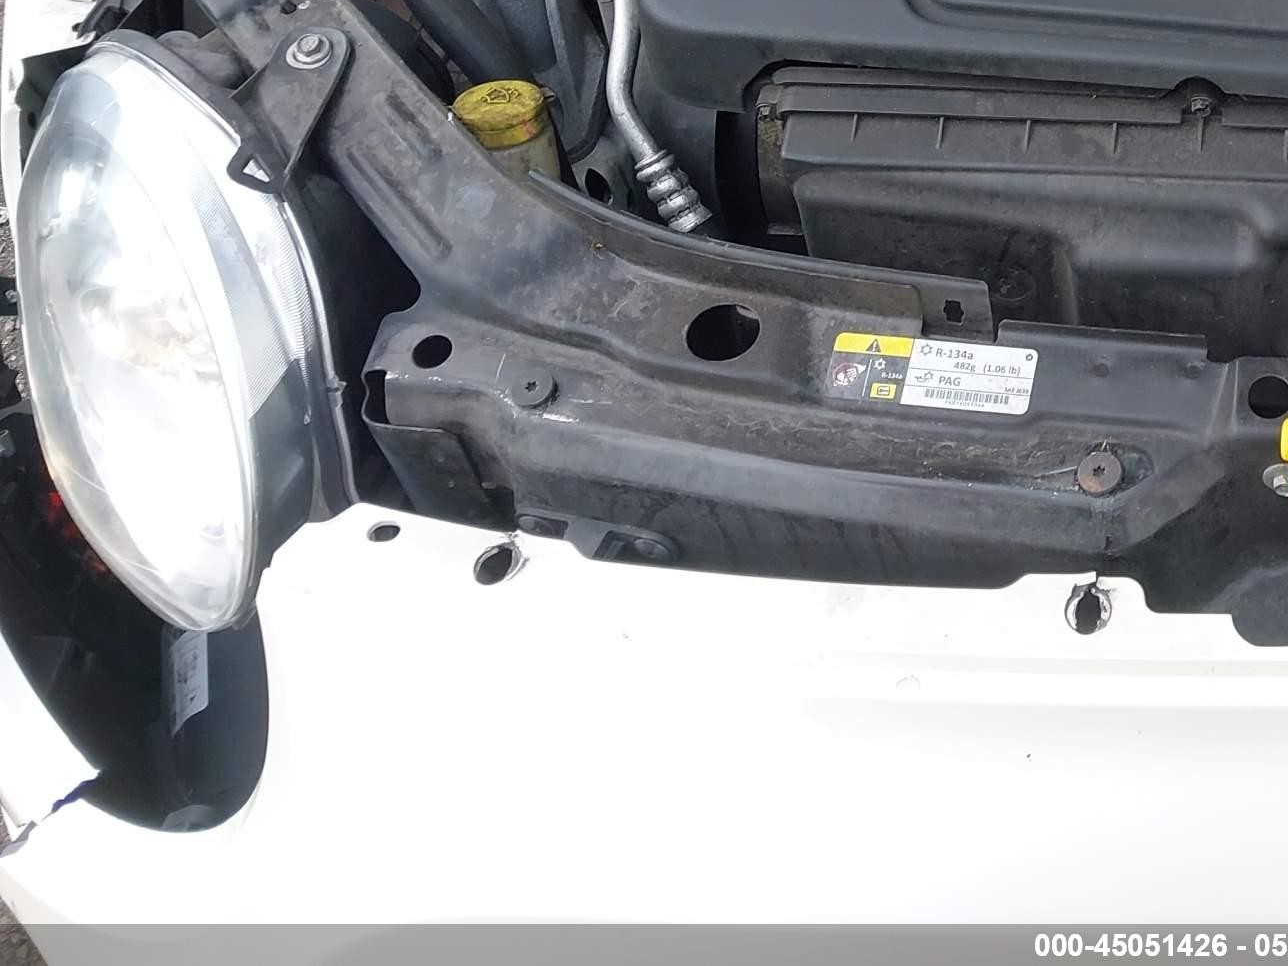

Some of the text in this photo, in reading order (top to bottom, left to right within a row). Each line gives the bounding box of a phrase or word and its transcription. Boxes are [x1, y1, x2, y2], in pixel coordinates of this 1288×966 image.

[935, 348, 974, 361] R-134a
[954, 362, 1021, 376] 482g (1.06 lb)
[881, 371, 903, 380] R-134a
[939, 375, 961, 387] PAG
